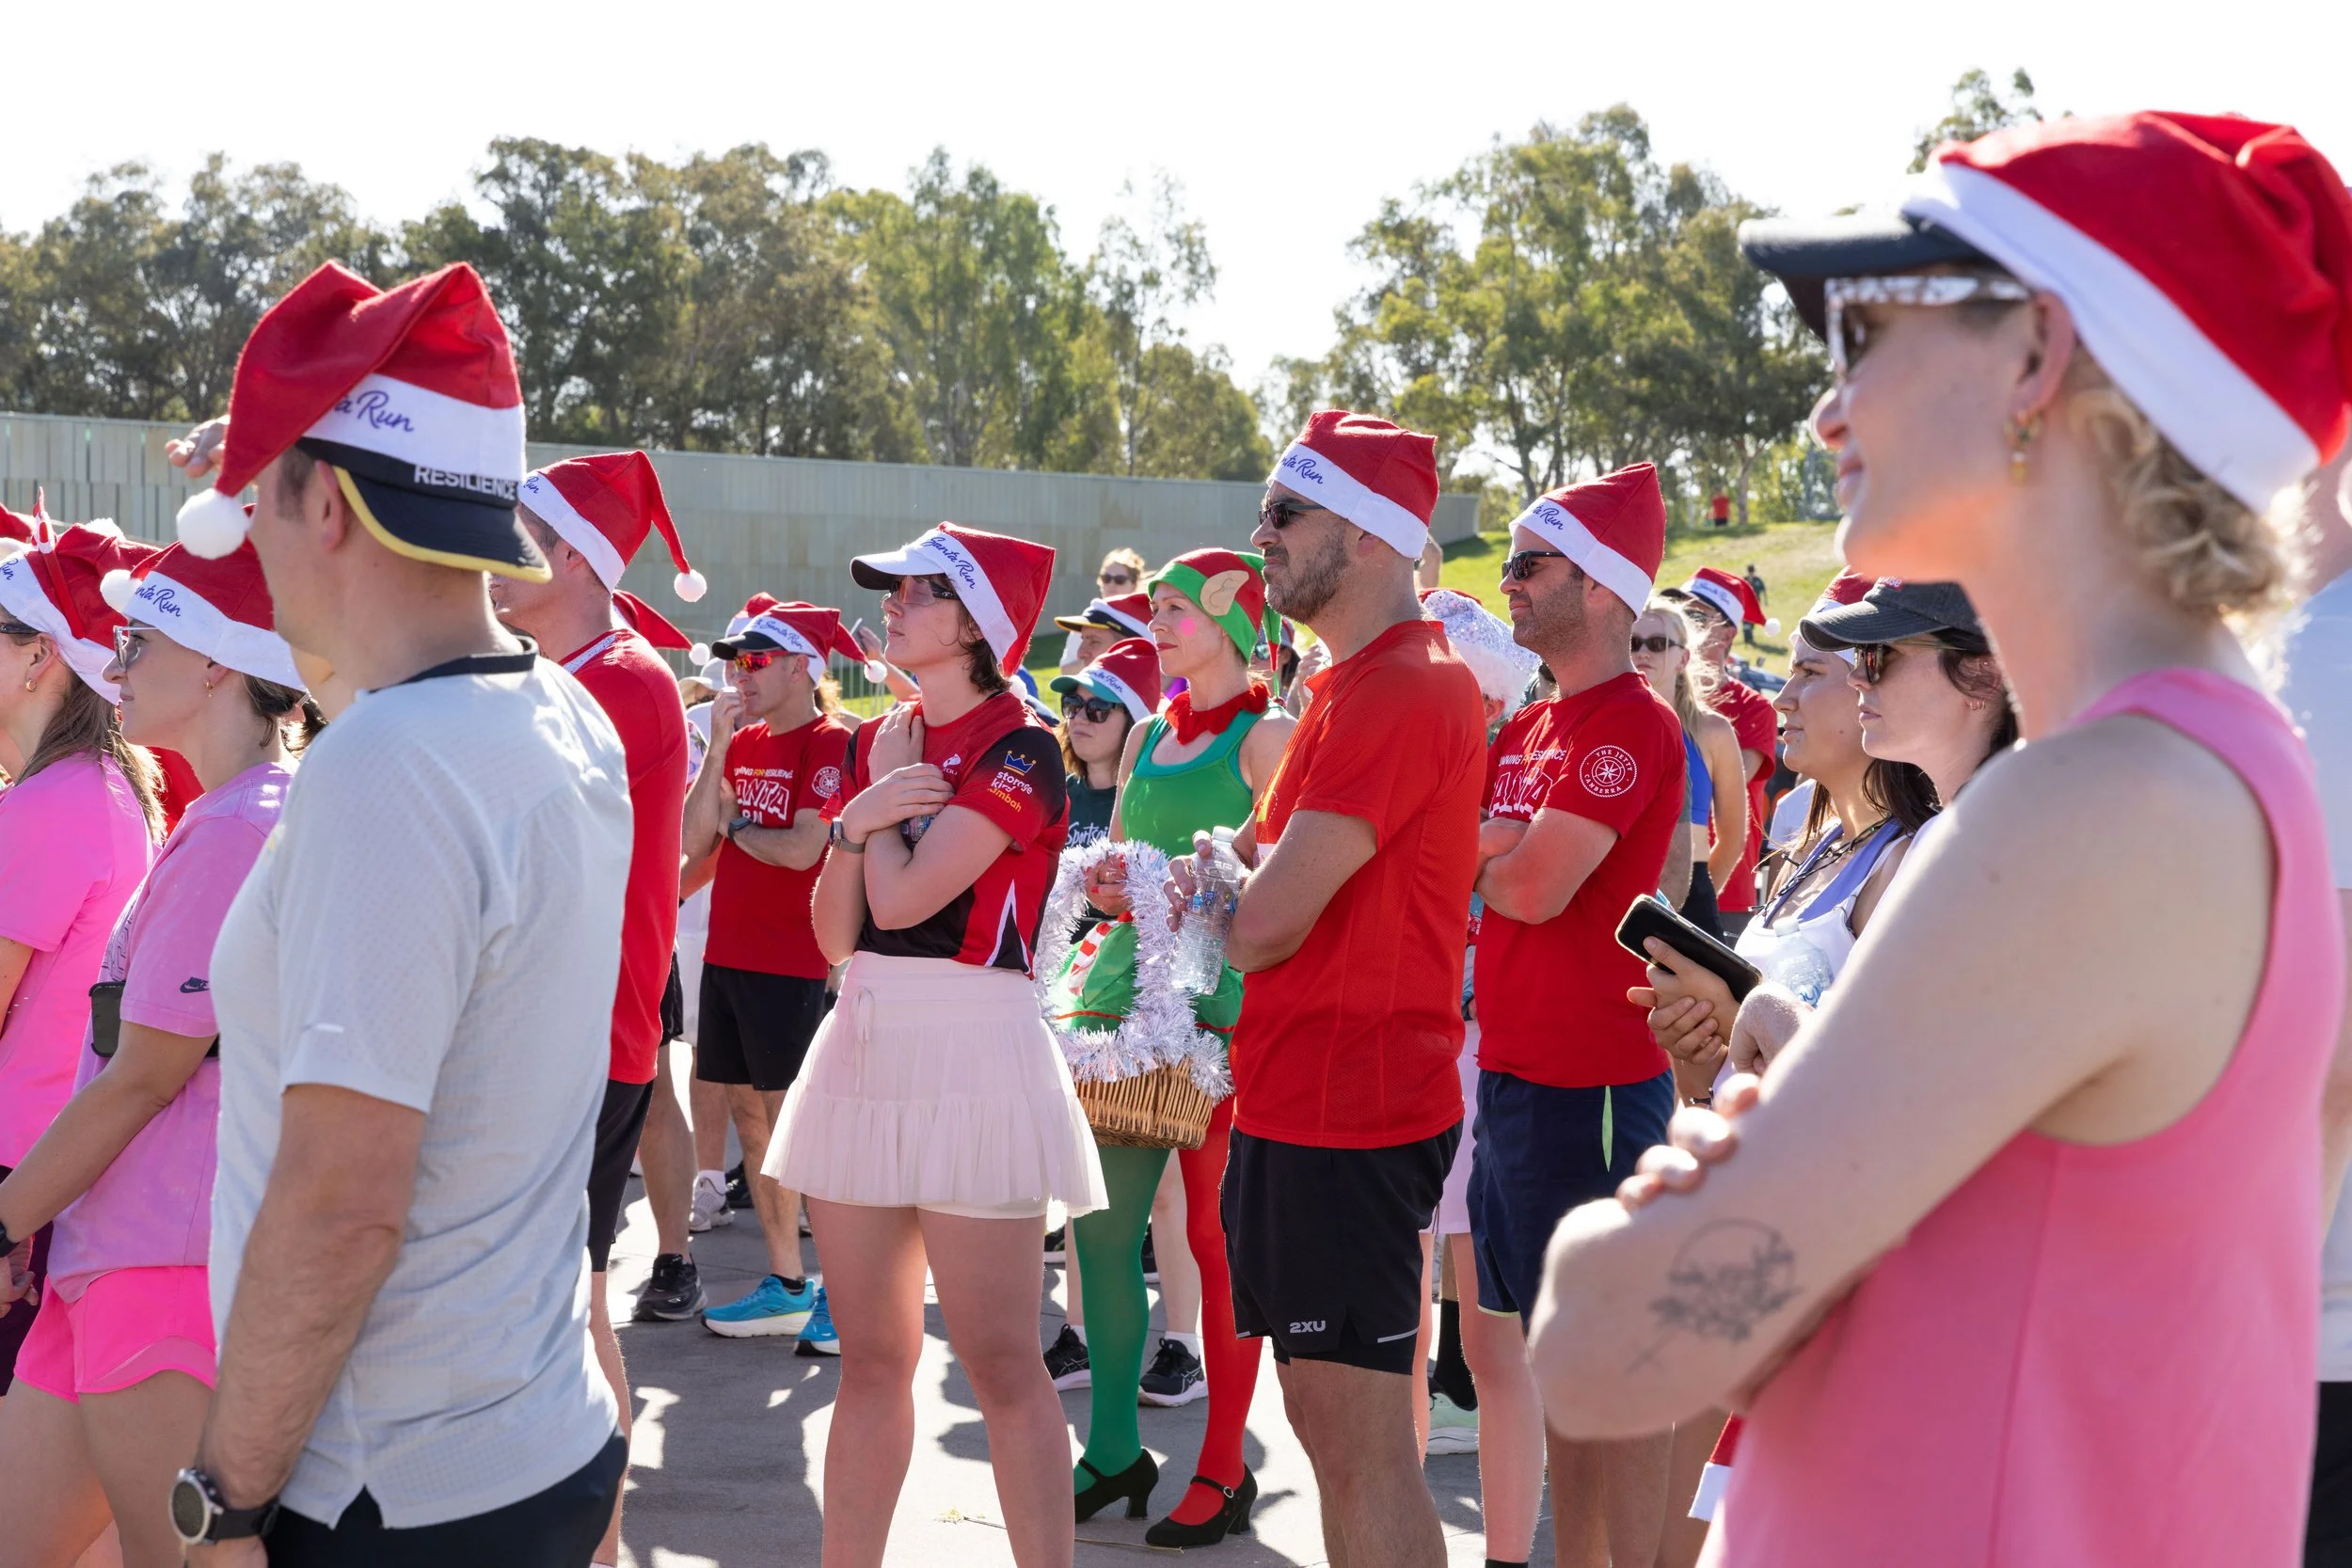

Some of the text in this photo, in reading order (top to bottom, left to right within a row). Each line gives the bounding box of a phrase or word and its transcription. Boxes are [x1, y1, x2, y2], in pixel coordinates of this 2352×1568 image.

[357, 390, 414, 433] Run
[414, 465, 516, 500] RESILIENCE
[1295, 458, 1324, 484] Run
[1540, 508, 1564, 531] Run
[920, 537, 976, 590] Santa Run
[135, 584, 182, 618] nta Run
[759, 620, 788, 637] Santa
[787, 632, 803, 650] Run
[1105, 675, 1123, 693] Run
[1596, 749, 1634, 771] THE JETTY
[996, 771, 1033, 795] storage
[1583, 773, 1623, 794] CANBERRA
[1289, 1320, 1327, 1334] 2XU
